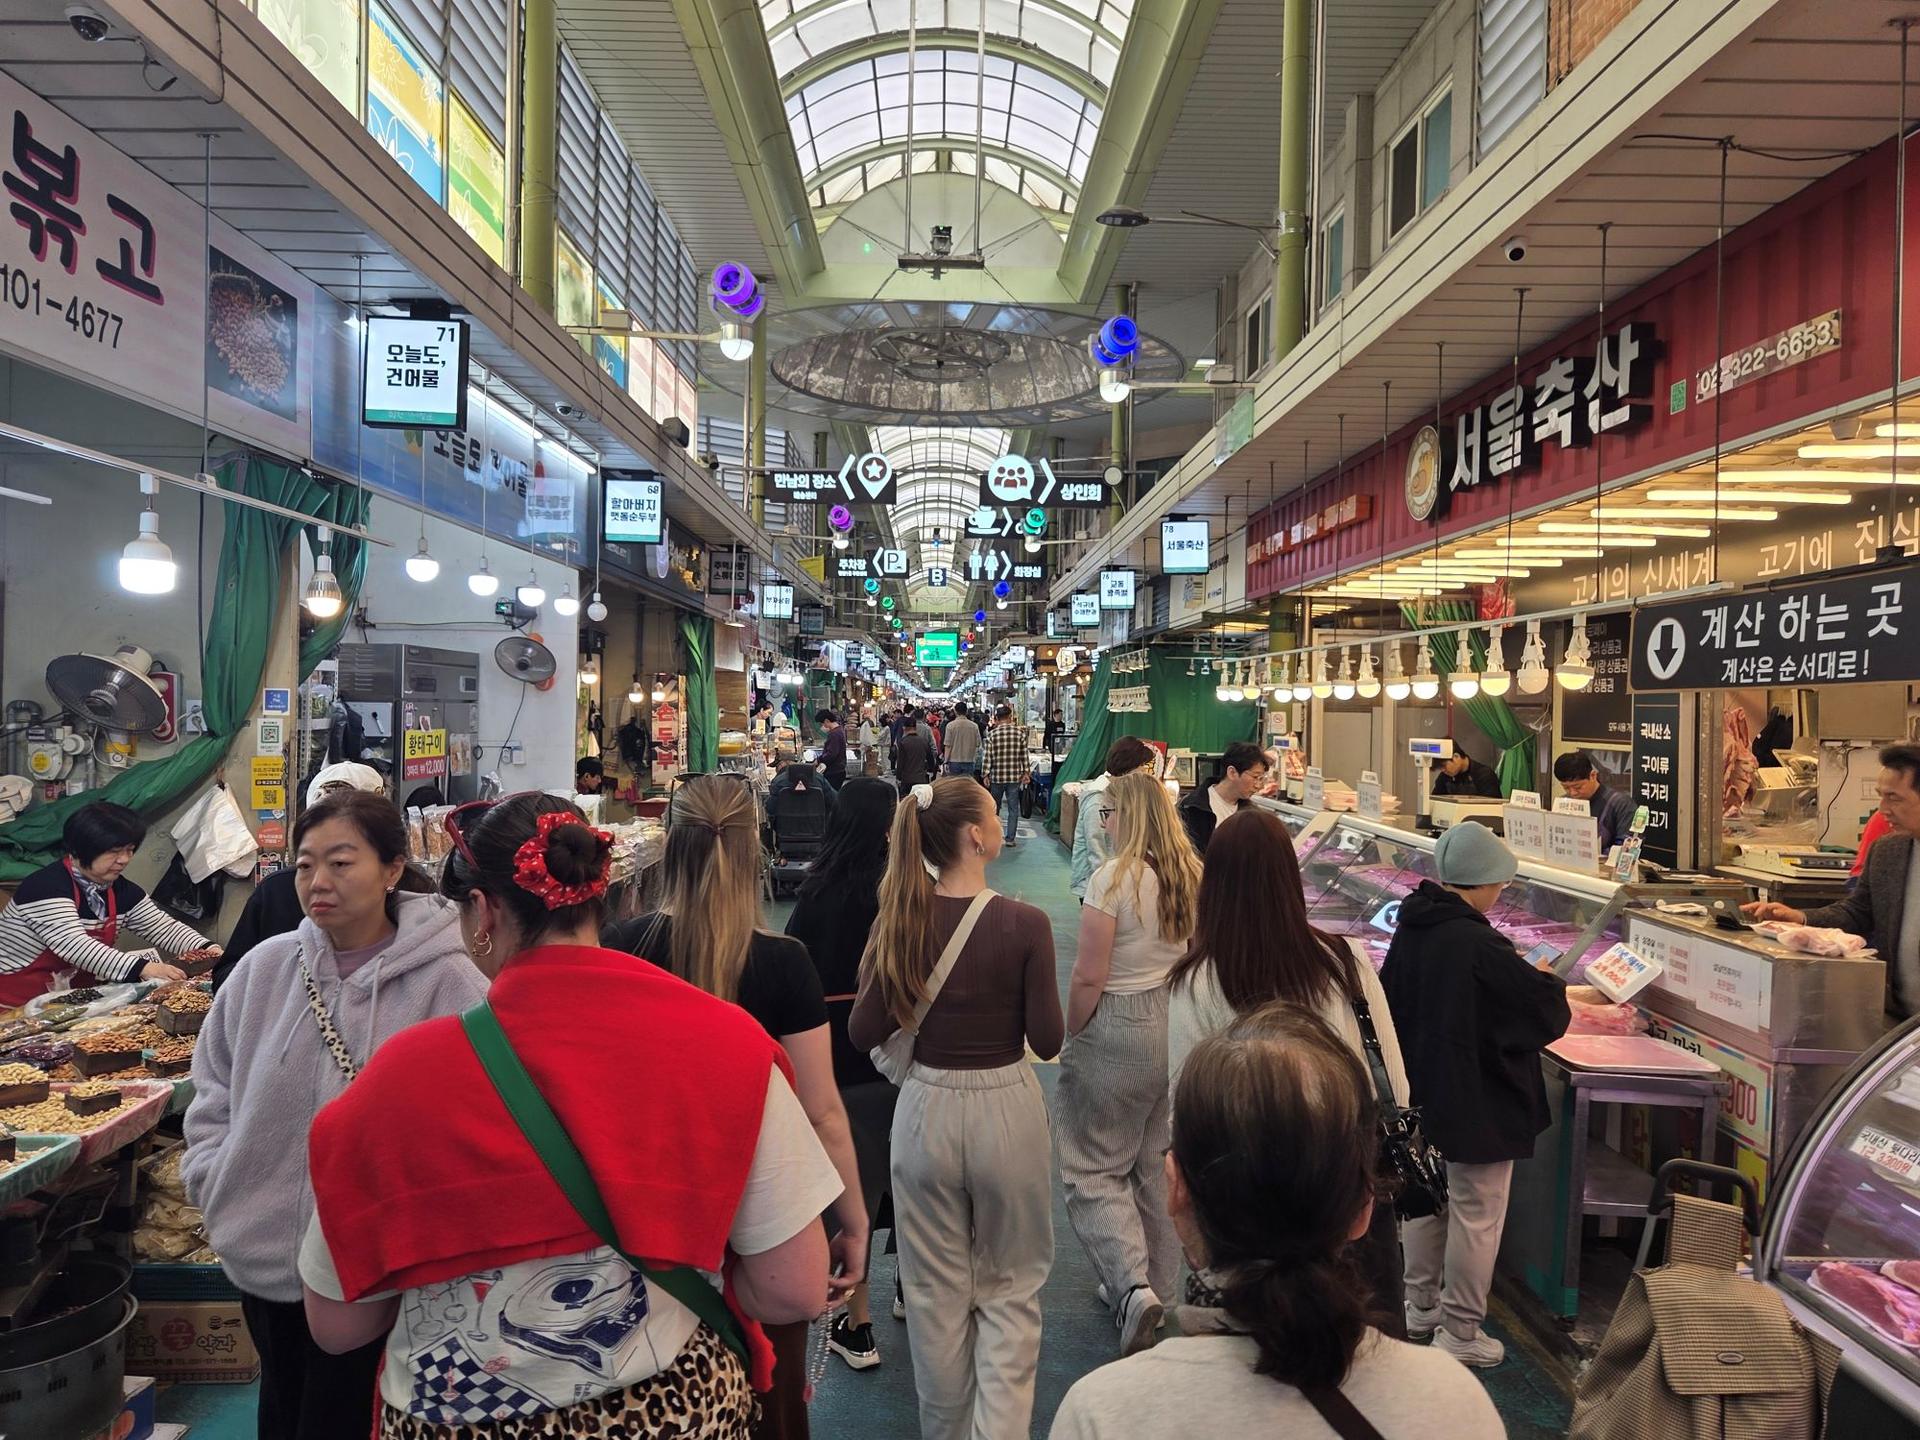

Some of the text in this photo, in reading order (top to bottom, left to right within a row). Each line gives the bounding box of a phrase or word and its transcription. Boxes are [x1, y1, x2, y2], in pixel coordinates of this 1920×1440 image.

[2, 110, 164, 305] 볶고
[437, 327, 455, 342] 71
[387, 344, 446, 367] 오늘도,
[387, 368, 440, 388] 건어물
[1449, 323, 1640, 493] 서울축산
[774, 473, 836, 489] 만남의 장소
[1060, 484, 1102, 501] 상인회
[611, 497, 656, 511] 할아버지
[1166, 540, 1204, 551] 서울축산
[1757, 530, 1833, 577] 고기에
[838, 558, 867, 571] 주차장
[1014, 565, 1042, 578] 화장실
[931, 569, 944, 582] B
[1571, 545, 1716, 606] 고기의 신세계
[1699, 582, 1903, 650] 계산 하는 곳
[1721, 649, 1870, 684] 계산은 순서대로!
[408, 734, 443, 755] 황태구이
[1641, 755, 1670, 774] 구이류
[1641, 782, 1669, 802] 국거리
[1645, 811, 1669, 829] 고기
[196, 1333, 237, 1355] 약과
